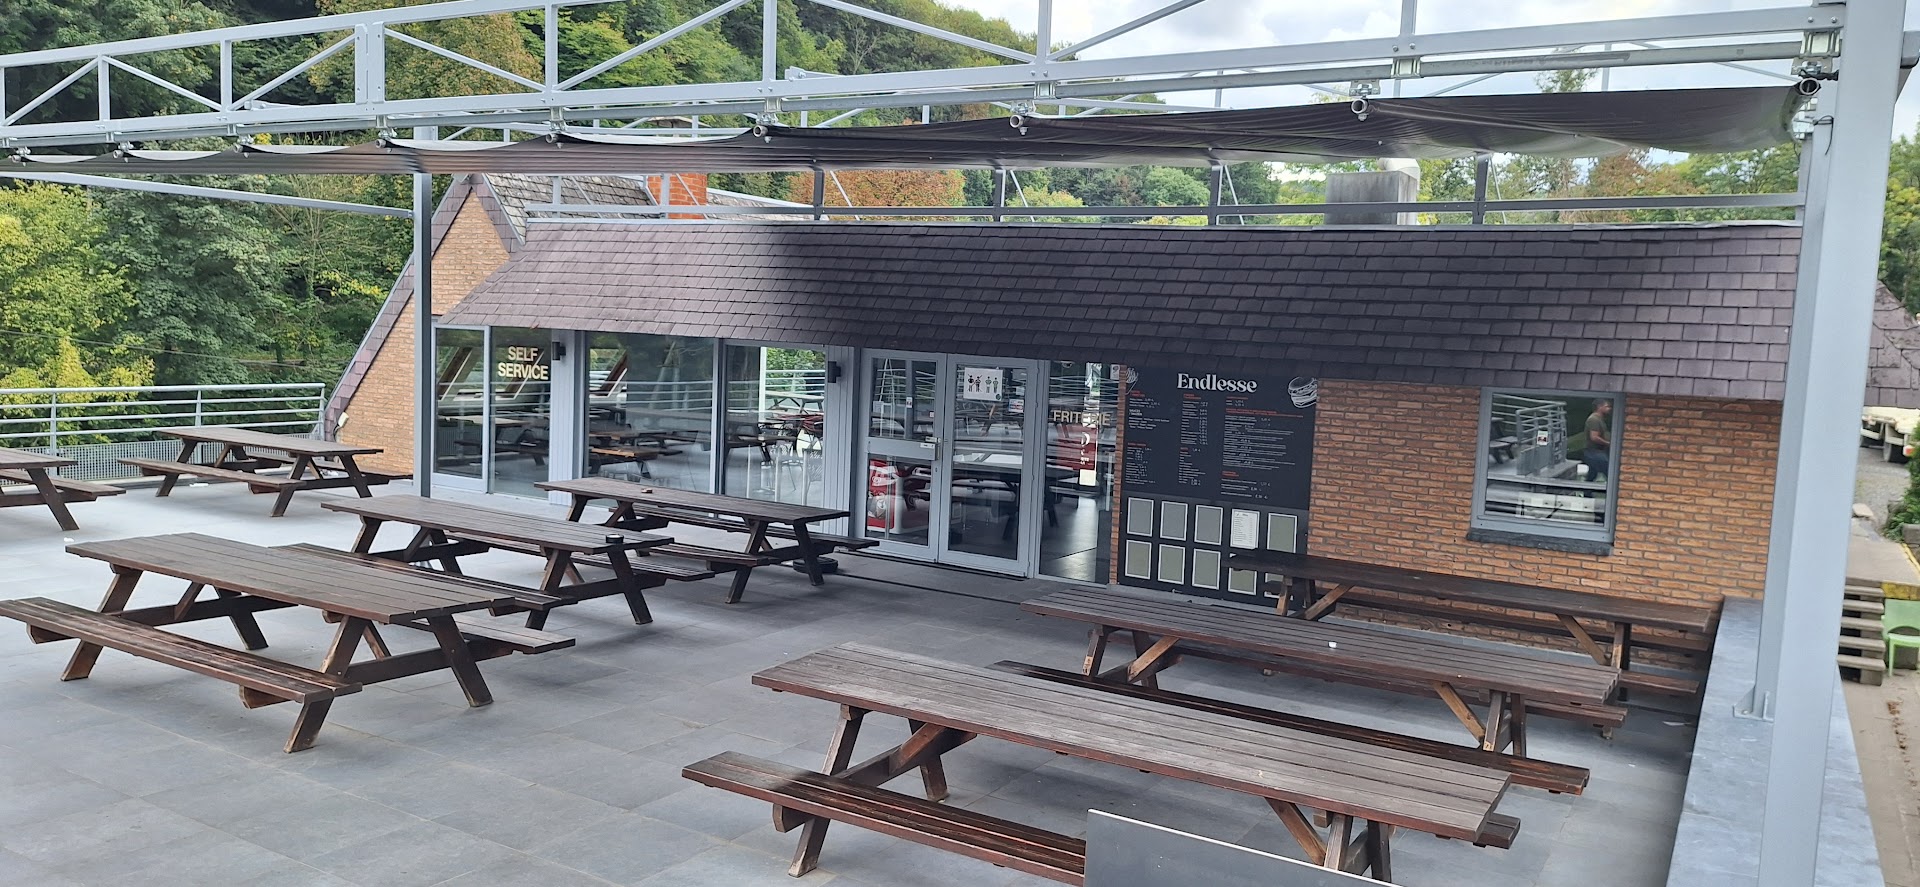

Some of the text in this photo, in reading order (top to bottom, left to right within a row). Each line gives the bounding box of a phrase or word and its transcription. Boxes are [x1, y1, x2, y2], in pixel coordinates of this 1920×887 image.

[508, 346, 538, 362] SELF
[498, 362, 549, 380] SERVICE
[1178, 373, 1258, 393] Endlesse
[1053, 410, 1111, 426] FRITERIE
